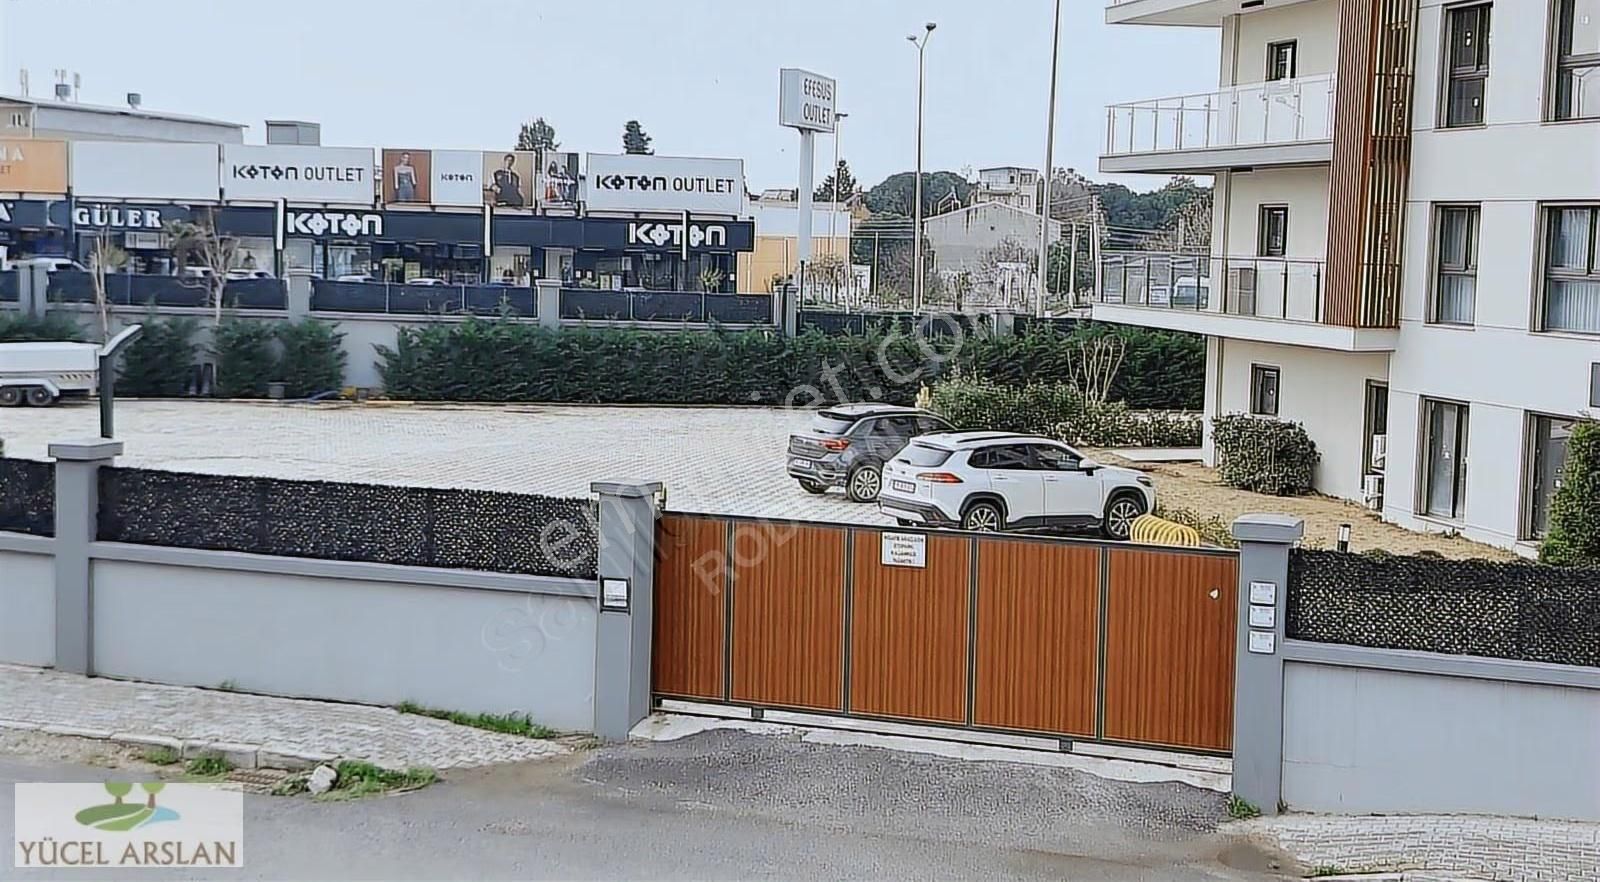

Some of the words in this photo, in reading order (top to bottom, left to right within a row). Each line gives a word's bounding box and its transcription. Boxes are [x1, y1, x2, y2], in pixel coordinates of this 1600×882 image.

[803, 78, 832, 101] EFESUS
[803, 103, 830, 124] OUTLET
[233, 164, 298, 181] KOTON
[304, 166, 365, 182] OUTLET
[596, 174, 667, 191] KOTON
[673, 177, 735, 194] OUTLET
[75, 203, 163, 229] GÜLER
[287, 212, 383, 237] KOTON
